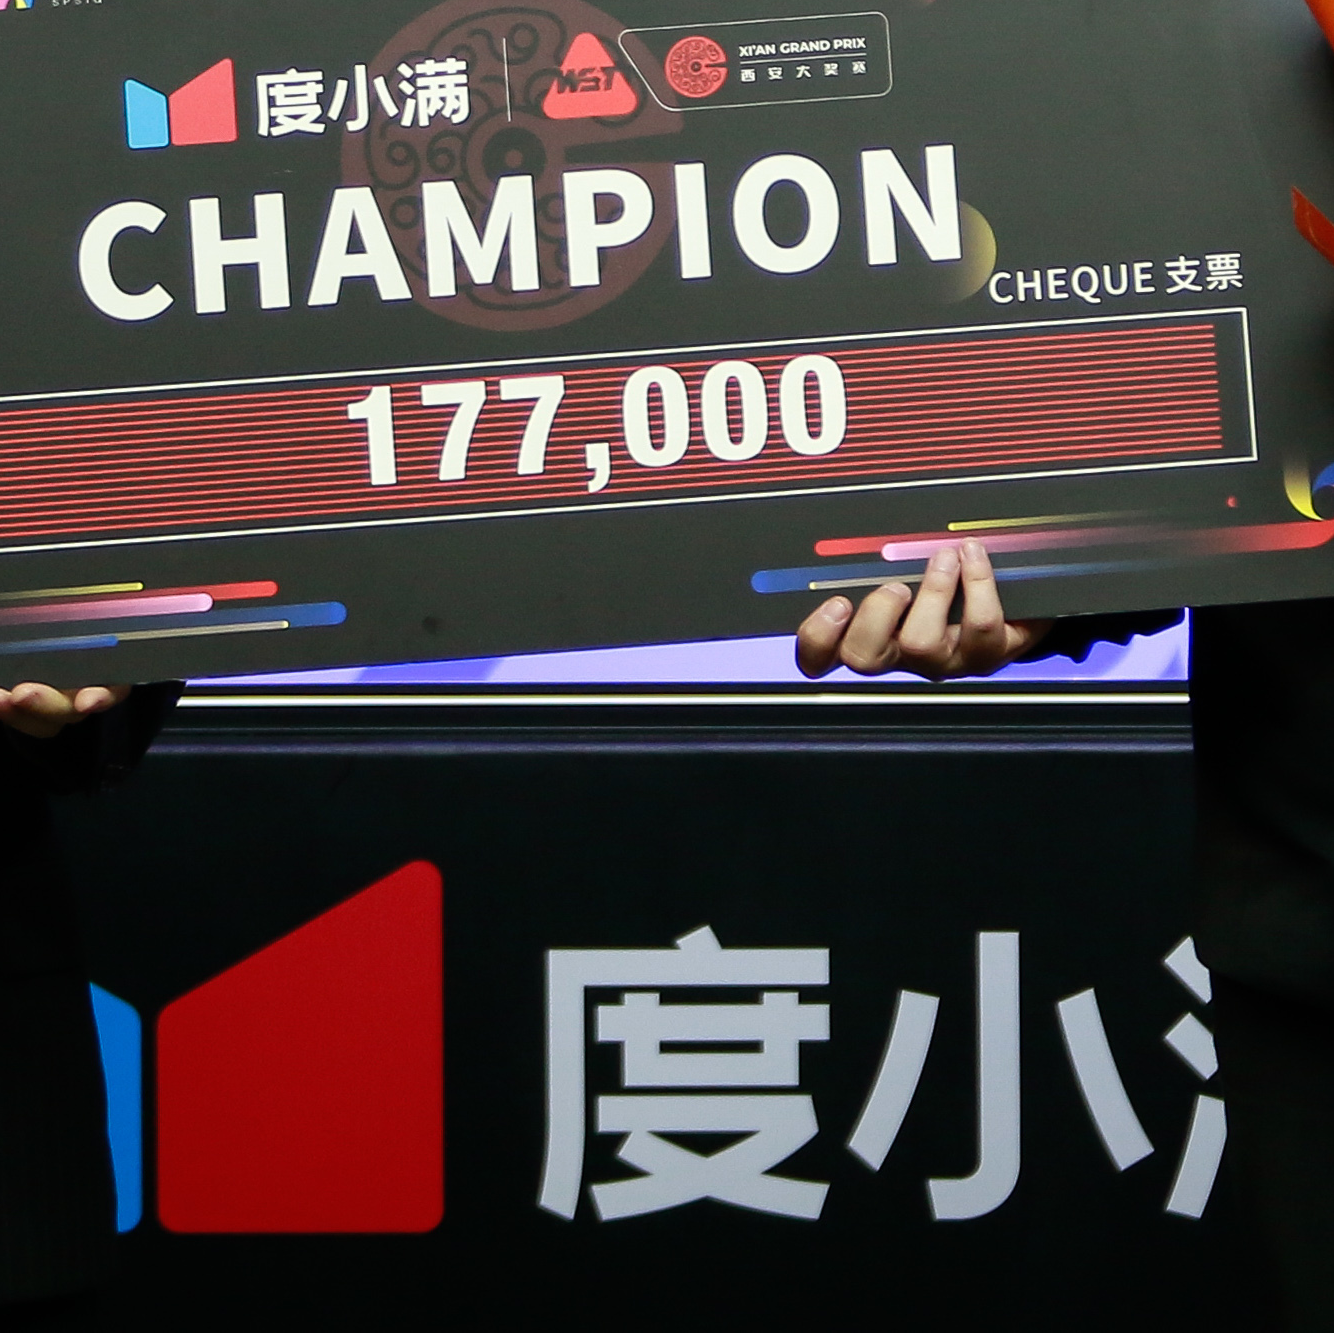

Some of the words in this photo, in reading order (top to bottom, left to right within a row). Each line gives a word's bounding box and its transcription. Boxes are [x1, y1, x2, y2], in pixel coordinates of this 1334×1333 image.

[256, 57, 471, 137] 度小满
[738, 44, 776, 57] XI'AN
[779, 39, 831, 54] GRAND
[833, 37, 867, 50] PRIX
[78, 143, 964, 322] CHAMPION
[988, 261, 1156, 304] CHEQUE
[1164, 252, 1244, 293] 支票
[346, 352, 849, 495] 177,000
[537, 924, 1228, 1222] 度小
